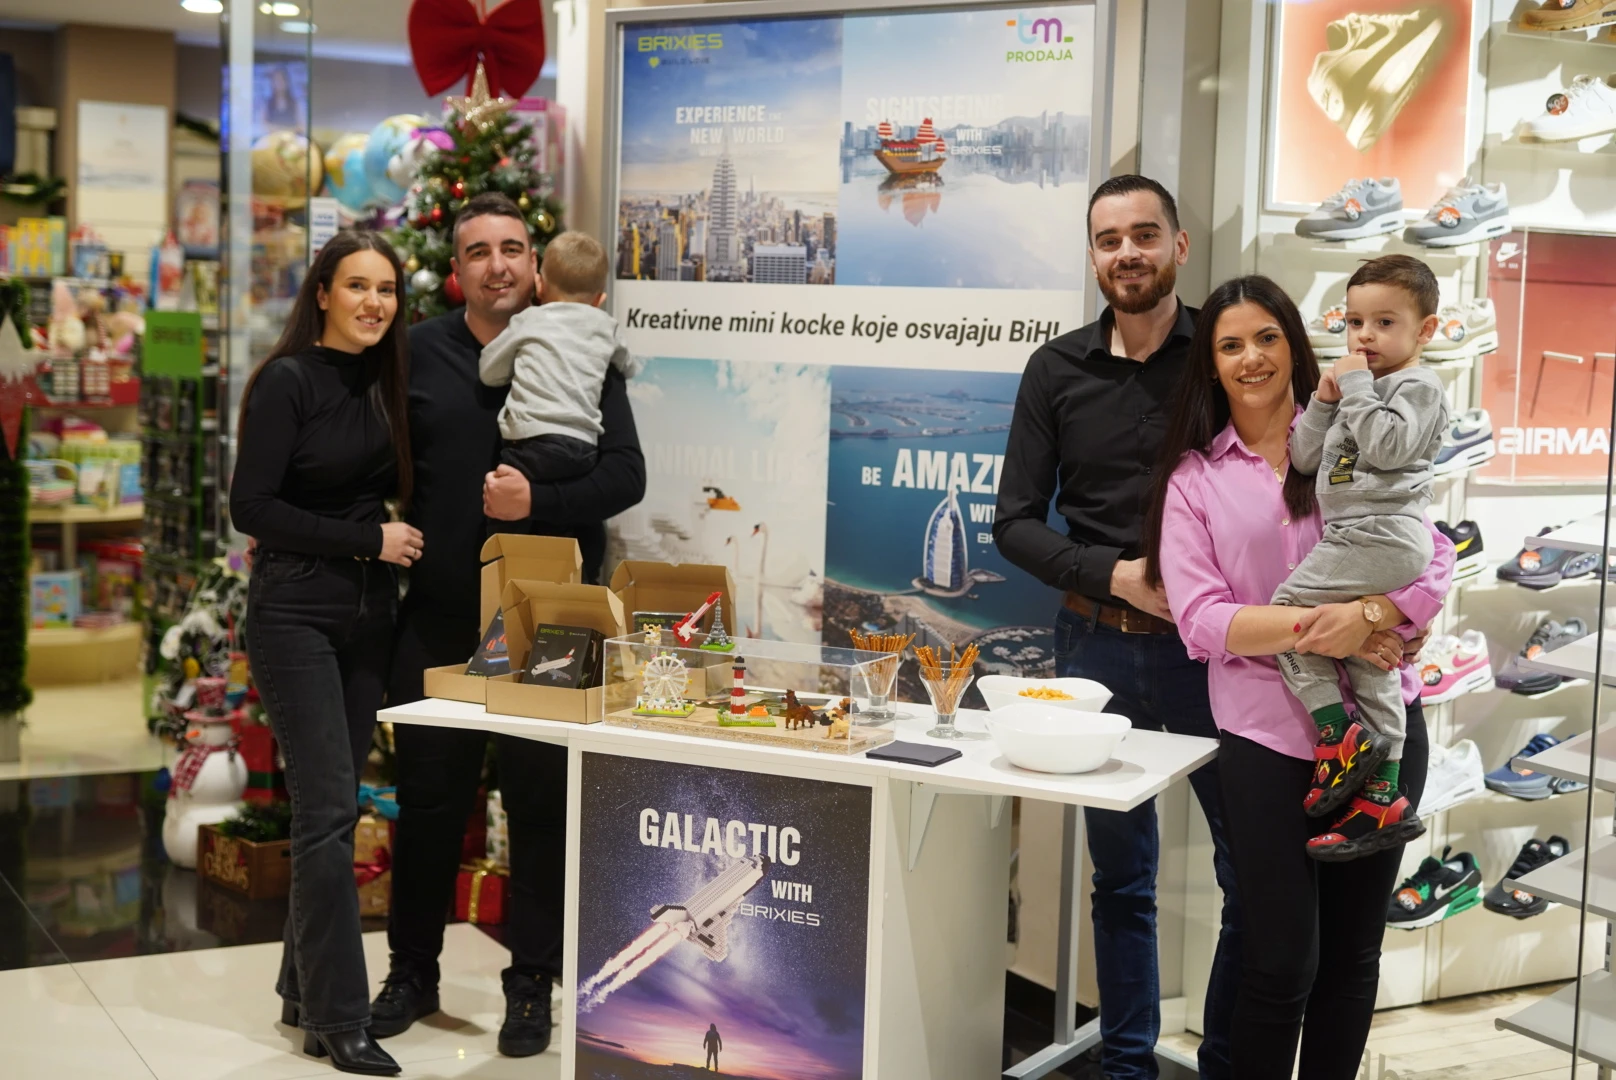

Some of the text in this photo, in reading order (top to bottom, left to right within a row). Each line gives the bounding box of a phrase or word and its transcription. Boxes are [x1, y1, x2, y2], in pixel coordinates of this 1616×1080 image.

[637, 33, 724, 52] BRIXIES
[1006, 49, 1073, 62] PRODAJA
[675, 105, 766, 124] EXPERIENCE
[690, 126, 784, 144] NEW WORLD
[956, 128, 983, 141] WITH
[950, 145, 1003, 155] BRIXIES
[626, 308, 723, 331] Kreativne
[728, 311, 776, 333] mini
[780, 312, 845, 336] kocke
[851, 314, 898, 343] koje
[905, 317, 1002, 347] osvajaju
[861, 448, 1006, 495] BE AMAZI
[969, 503, 997, 524] WIT
[1284, 651, 1302, 675] RNEY
[638, 807, 801, 866] GALACTIC
[770, 880, 812, 903] WITH
[740, 903, 821, 927] BRIXIES
